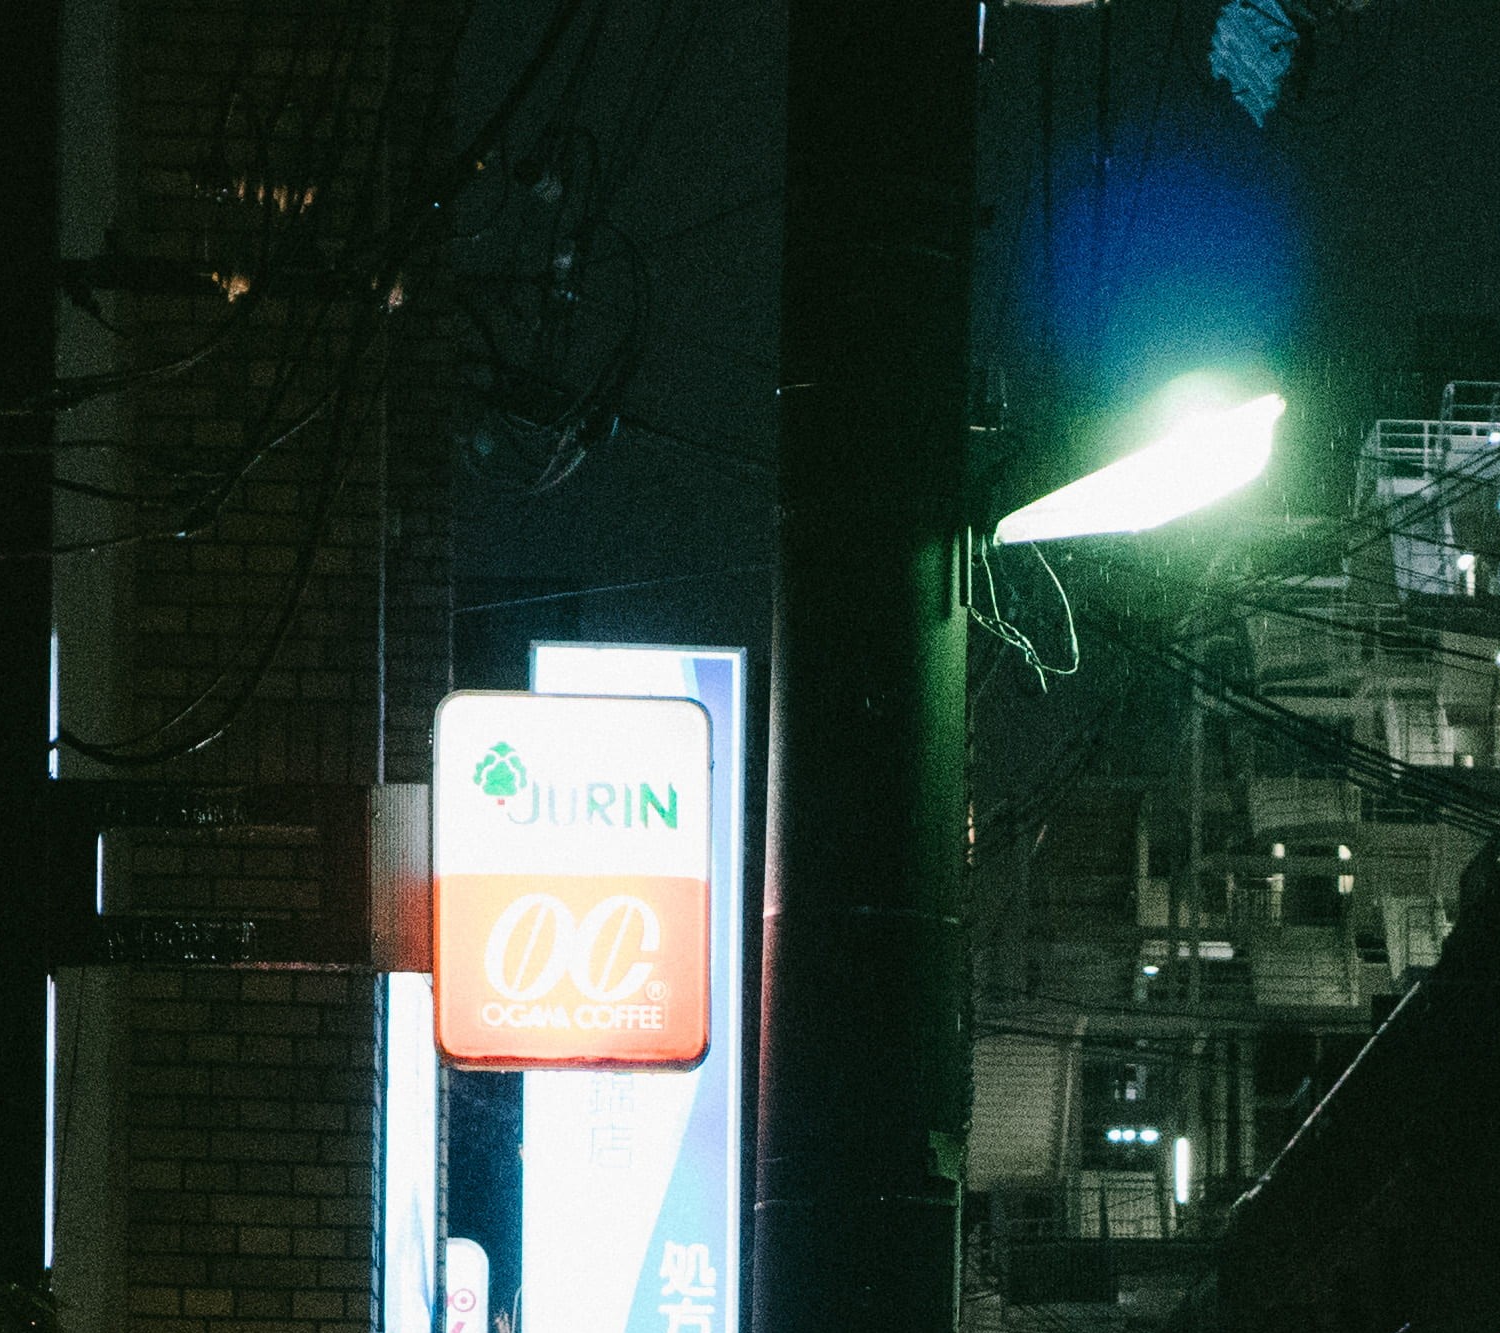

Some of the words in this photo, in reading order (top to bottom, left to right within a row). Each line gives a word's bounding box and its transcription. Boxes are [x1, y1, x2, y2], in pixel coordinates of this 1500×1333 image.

[507, 781, 679, 830] JURIN
[484, 893, 661, 1001] OC
[481, 1002, 571, 1028] OGAWA
[573, 1004, 663, 1030] COFFEE
